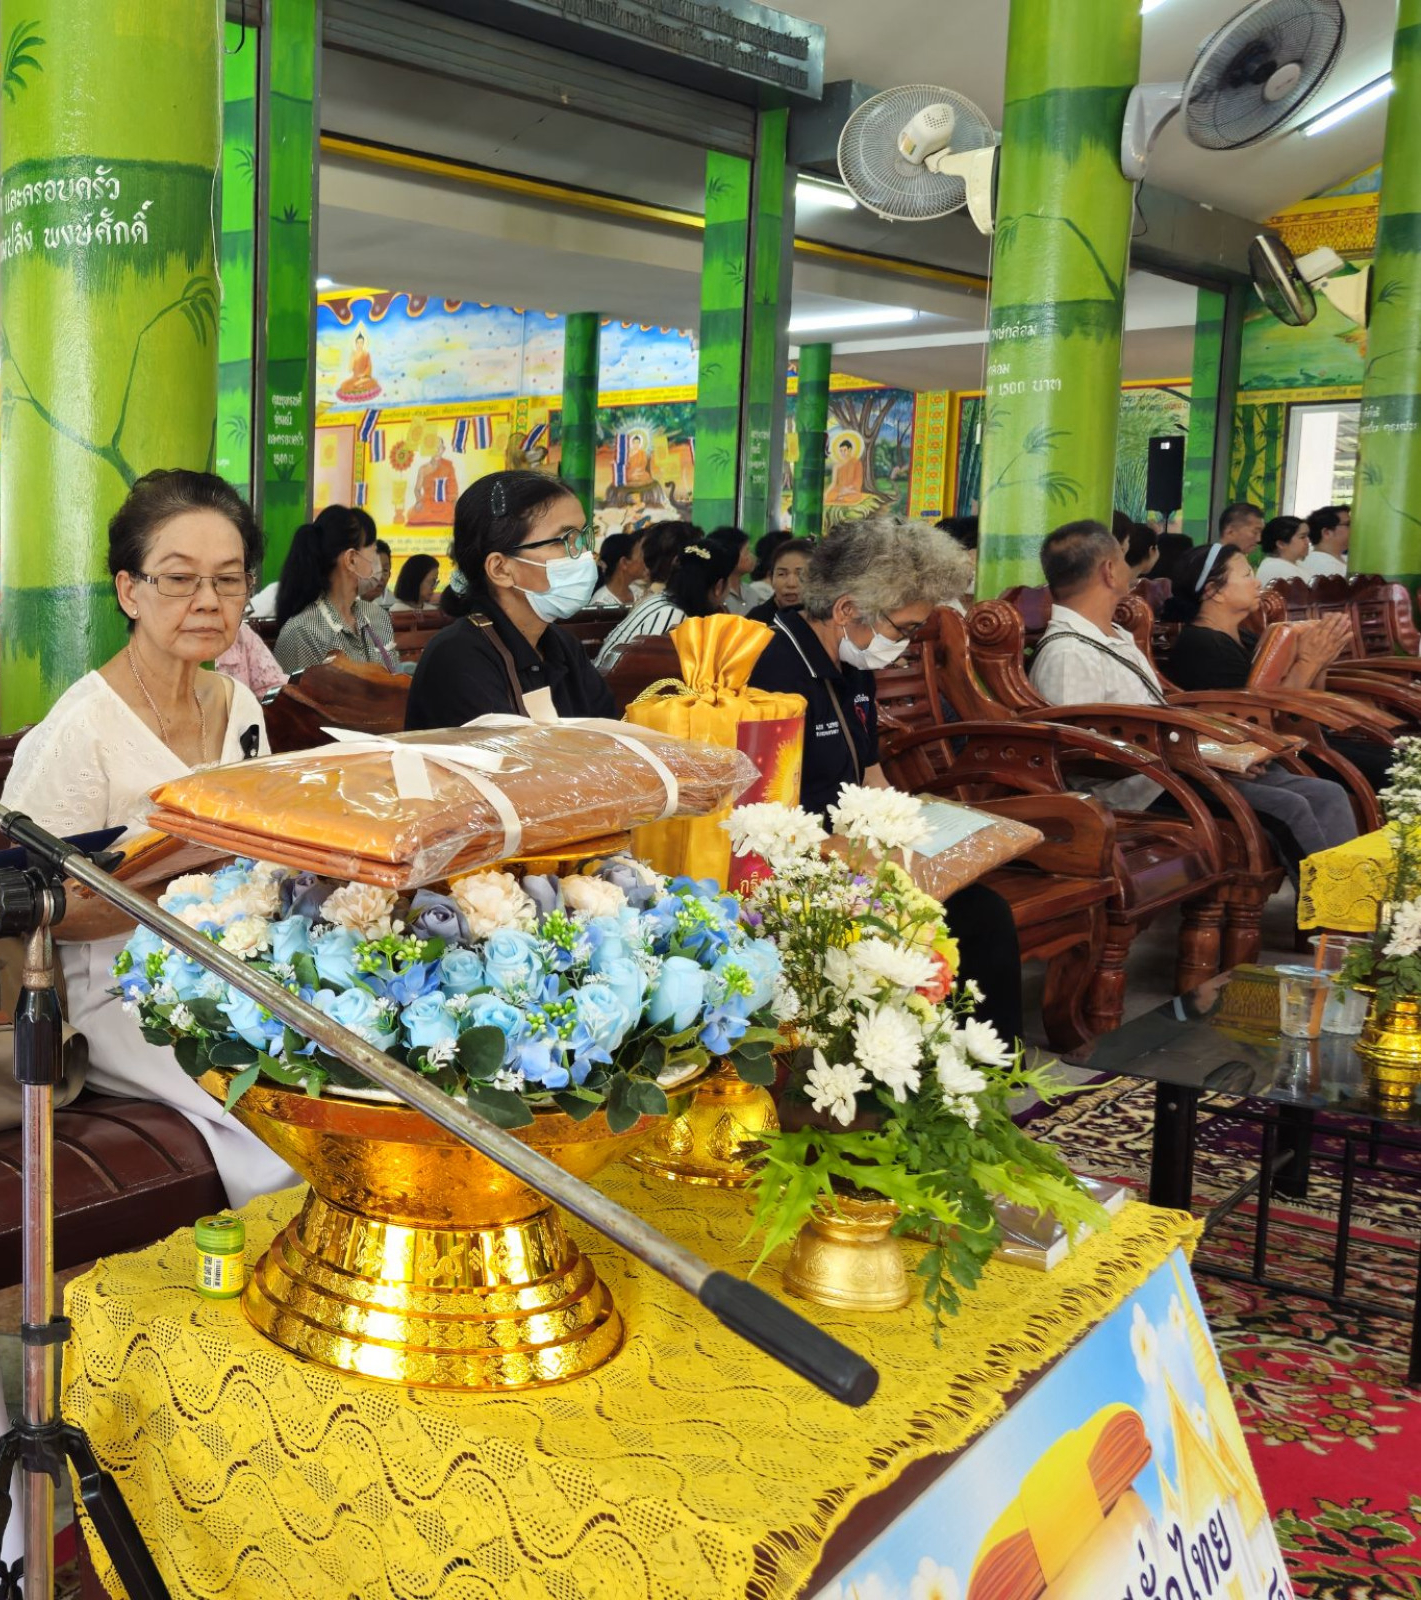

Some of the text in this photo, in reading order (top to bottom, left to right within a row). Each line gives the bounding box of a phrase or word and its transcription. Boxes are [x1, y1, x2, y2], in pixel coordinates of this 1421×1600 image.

[3, 164, 120, 214] และครอบครัว
[43, 200, 155, 249] พงษ์ศักดิ์
[1032, 378, 1062, 392] บาท
